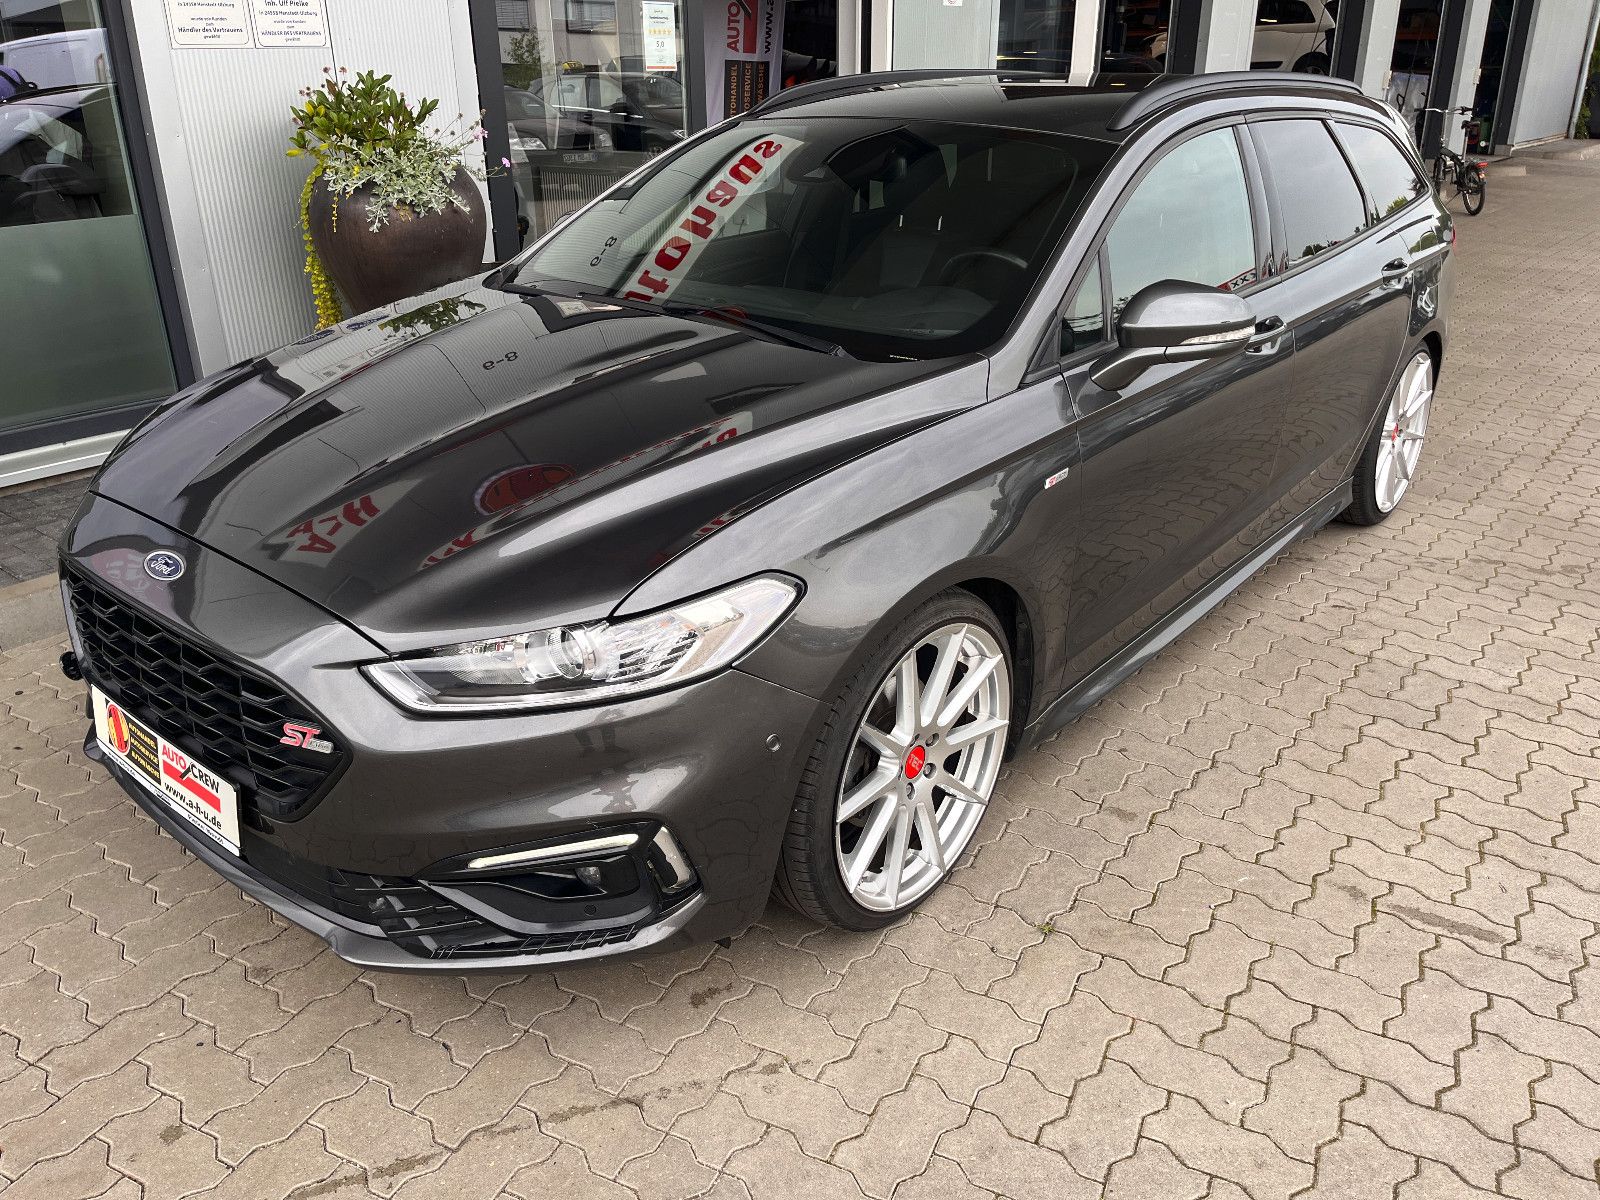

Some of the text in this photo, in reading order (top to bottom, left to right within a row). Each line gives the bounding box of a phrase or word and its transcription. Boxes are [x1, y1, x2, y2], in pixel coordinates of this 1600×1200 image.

[726, 1, 740, 53] AUTO
[150, 556, 176, 575] Ford
[280, 722, 322, 748] ST
[162, 744, 187, 770] AUTO
[191, 762, 220, 794] CREW
[164, 782, 222, 830] www.a-h-u.de
